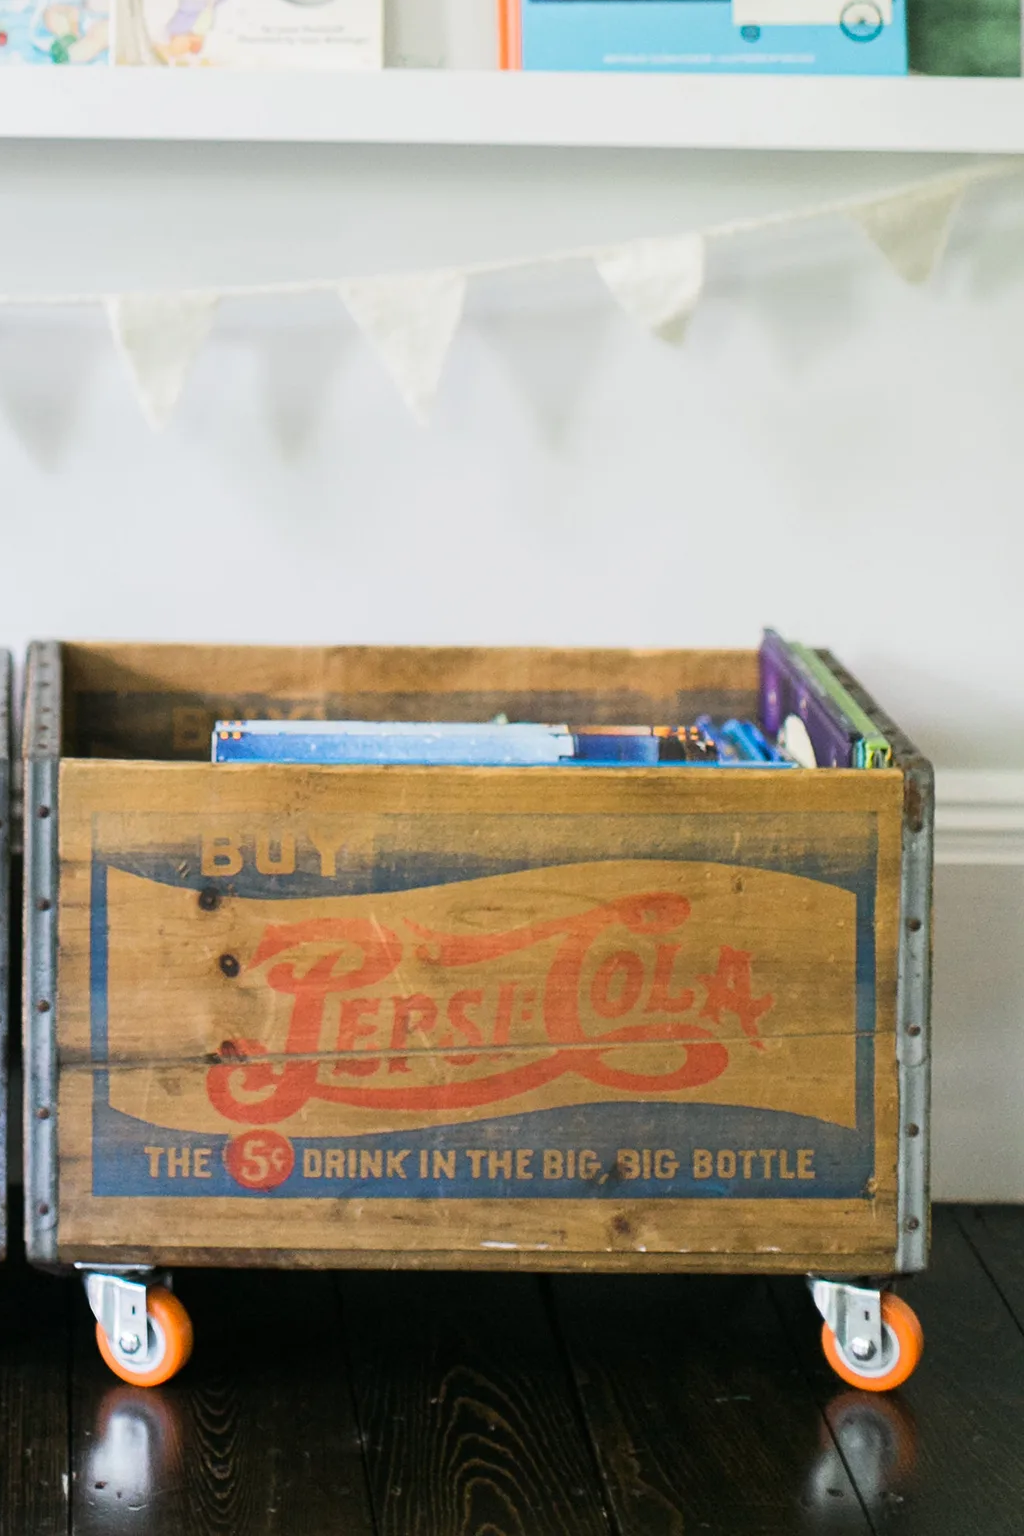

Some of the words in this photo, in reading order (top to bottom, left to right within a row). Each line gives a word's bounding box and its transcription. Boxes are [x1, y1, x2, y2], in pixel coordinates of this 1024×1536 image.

[201, 830, 348, 876] BUY
[144, 1146, 213, 1178] THE
[303, 1148, 411, 1179] DRINK
[420, 1149, 456, 1180] IN
[466, 1149, 534, 1180] THE
[617, 1149, 681, 1180] BIG
[693, 1148, 816, 1180] BOTTLE
